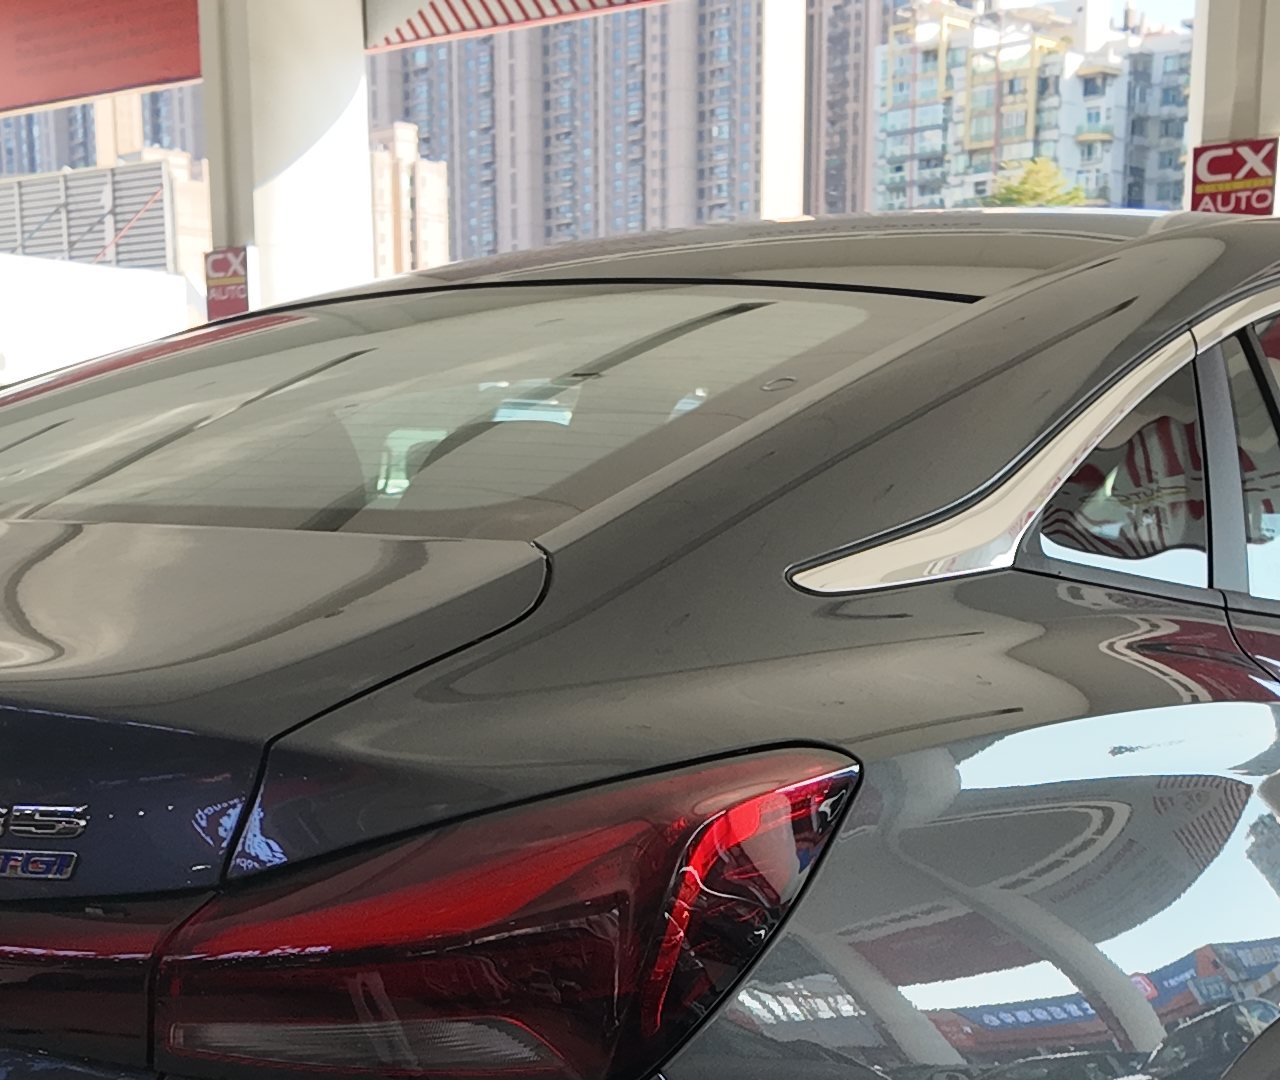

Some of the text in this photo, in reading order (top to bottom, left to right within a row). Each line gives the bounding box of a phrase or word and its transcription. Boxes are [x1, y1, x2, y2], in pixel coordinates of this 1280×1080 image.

[1195, 142, 1275, 183] CX
[1196, 189, 1272, 213] AUTO
[206, 252, 245, 278] CX
[209, 285, 247, 300] AUTO
